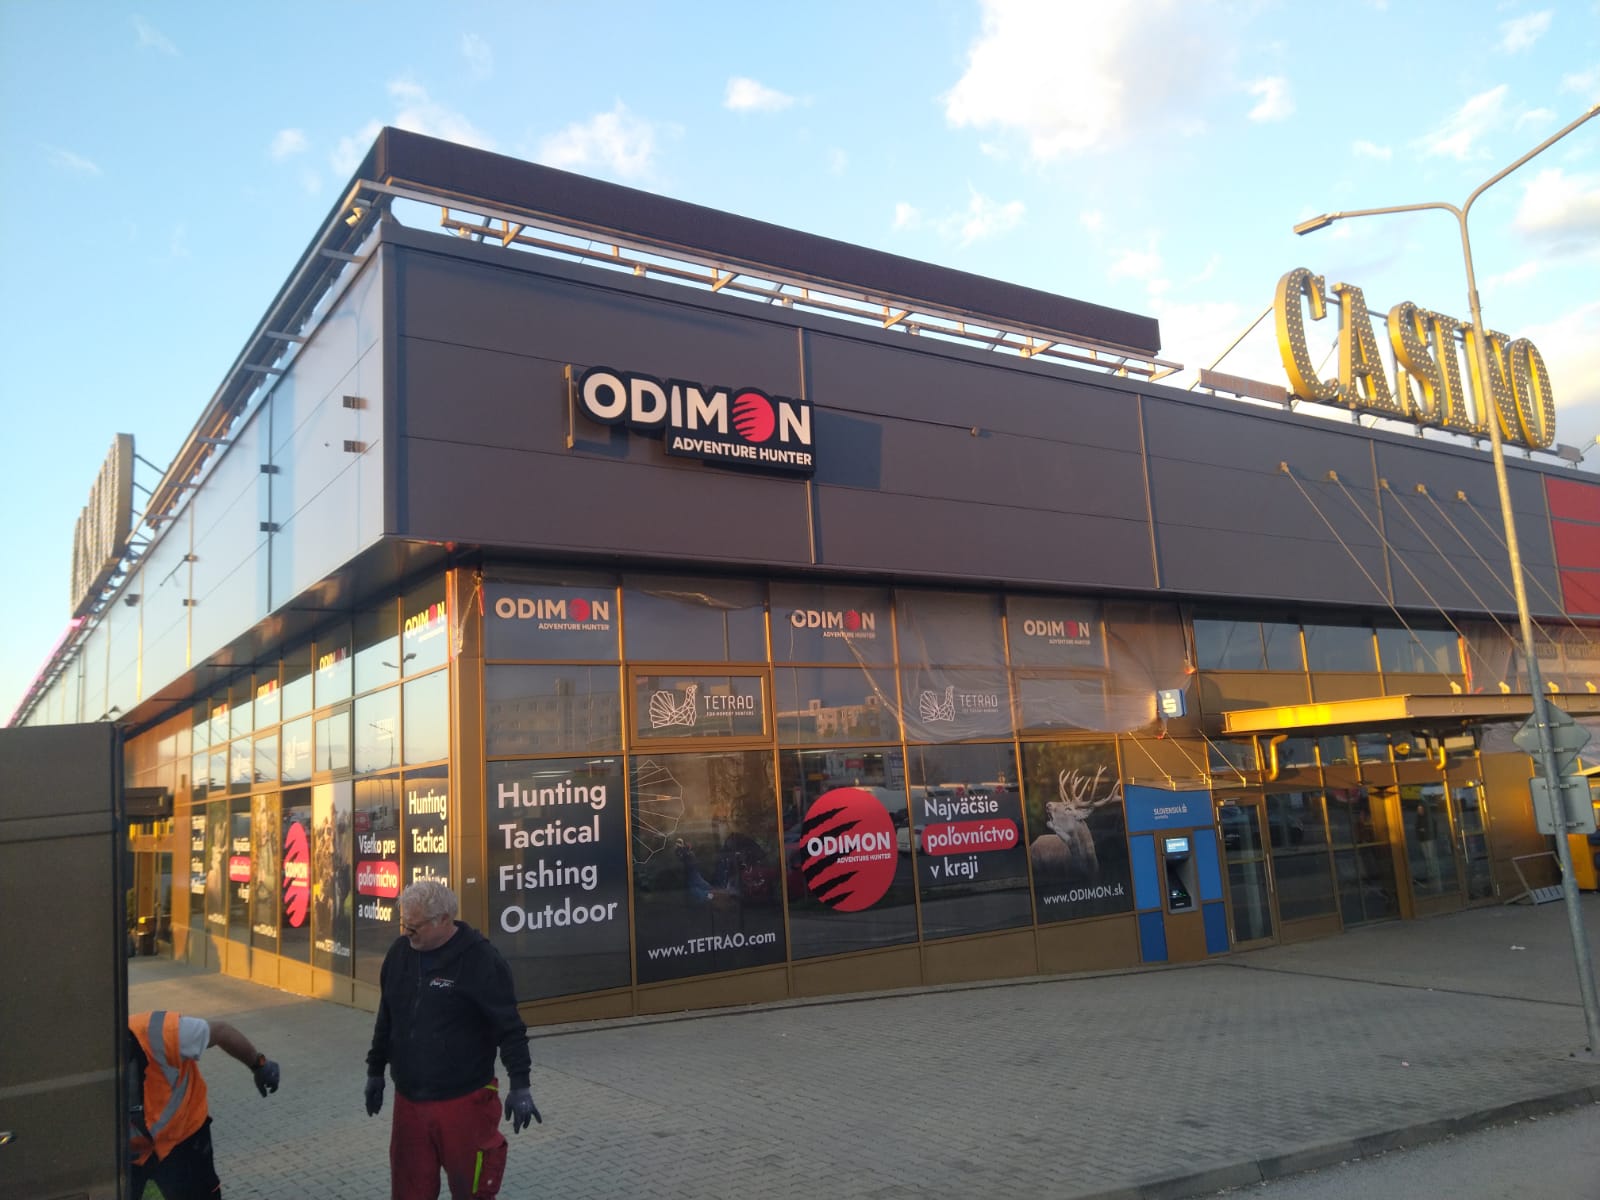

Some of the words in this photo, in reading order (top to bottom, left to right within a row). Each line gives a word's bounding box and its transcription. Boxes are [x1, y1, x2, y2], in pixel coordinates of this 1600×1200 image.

[1274, 267, 1556, 449] CASINO
[583, 372, 811, 445] ODIMON
[672, 436, 757, 459] ADVENTURE
[760, 447, 812, 465] HUNTER
[496, 597, 609, 622] ODIMON
[791, 608, 875, 631] ODIMON
[538, 622, 581, 630] ADVENTURE
[582, 623, 609, 631] HUNTER
[1023, 619, 1090, 638] ODIMON
[703, 695, 754, 710] TETRAO
[960, 694, 998, 708] TETRAO
[408, 788, 447, 820] Hunting
[497, 779, 607, 810] Hunting
[924, 795, 999, 821] Najväčšie
[358, 832, 381, 854] Všetko
[383, 839, 396, 860] pre
[411, 825, 447, 853] Tactical
[498, 815, 600, 850] Tactical
[806, 830, 891, 857] ODIMON
[926, 825, 1015, 853] poľovníctvo
[499, 859, 598, 892] Fishing
[930, 864, 939, 879] v
[944, 855, 978, 880] kraji
[1043, 885, 1125, 905] www.ODIMON.sk
[358, 904, 363, 918] a
[364, 898, 392, 922] outdoor
[500, 897, 618, 934] Outdoor
[648, 931, 776, 960] www.TETRAO.com
